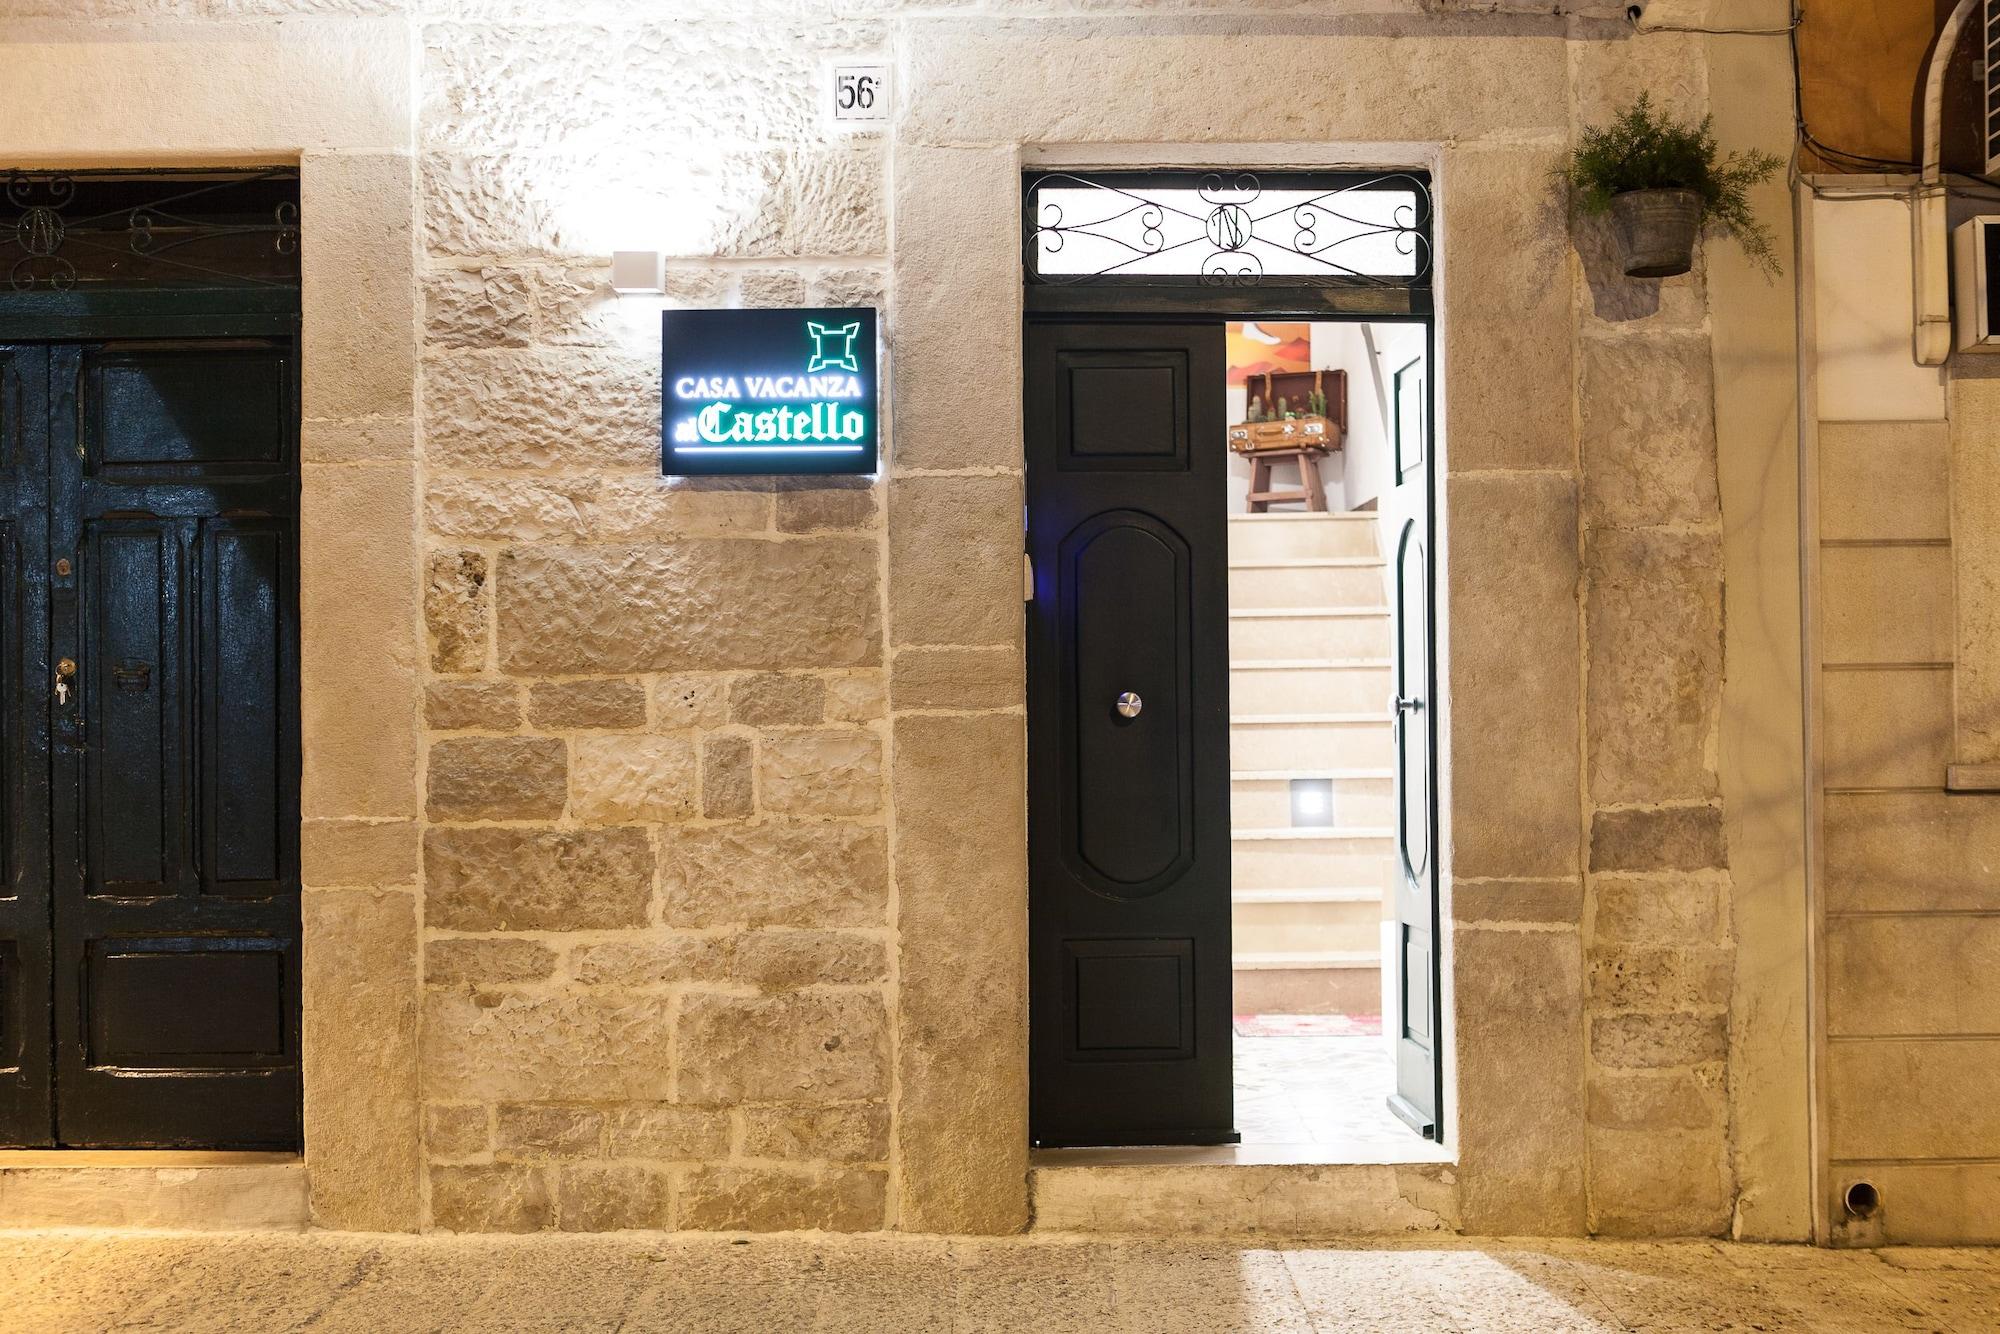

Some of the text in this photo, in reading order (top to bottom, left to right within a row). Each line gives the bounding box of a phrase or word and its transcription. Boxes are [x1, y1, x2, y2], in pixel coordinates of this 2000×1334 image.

[838, 75, 874, 110] 56
[676, 376, 862, 399] CASA VACANZA
[697, 401, 864, 442] Castello
